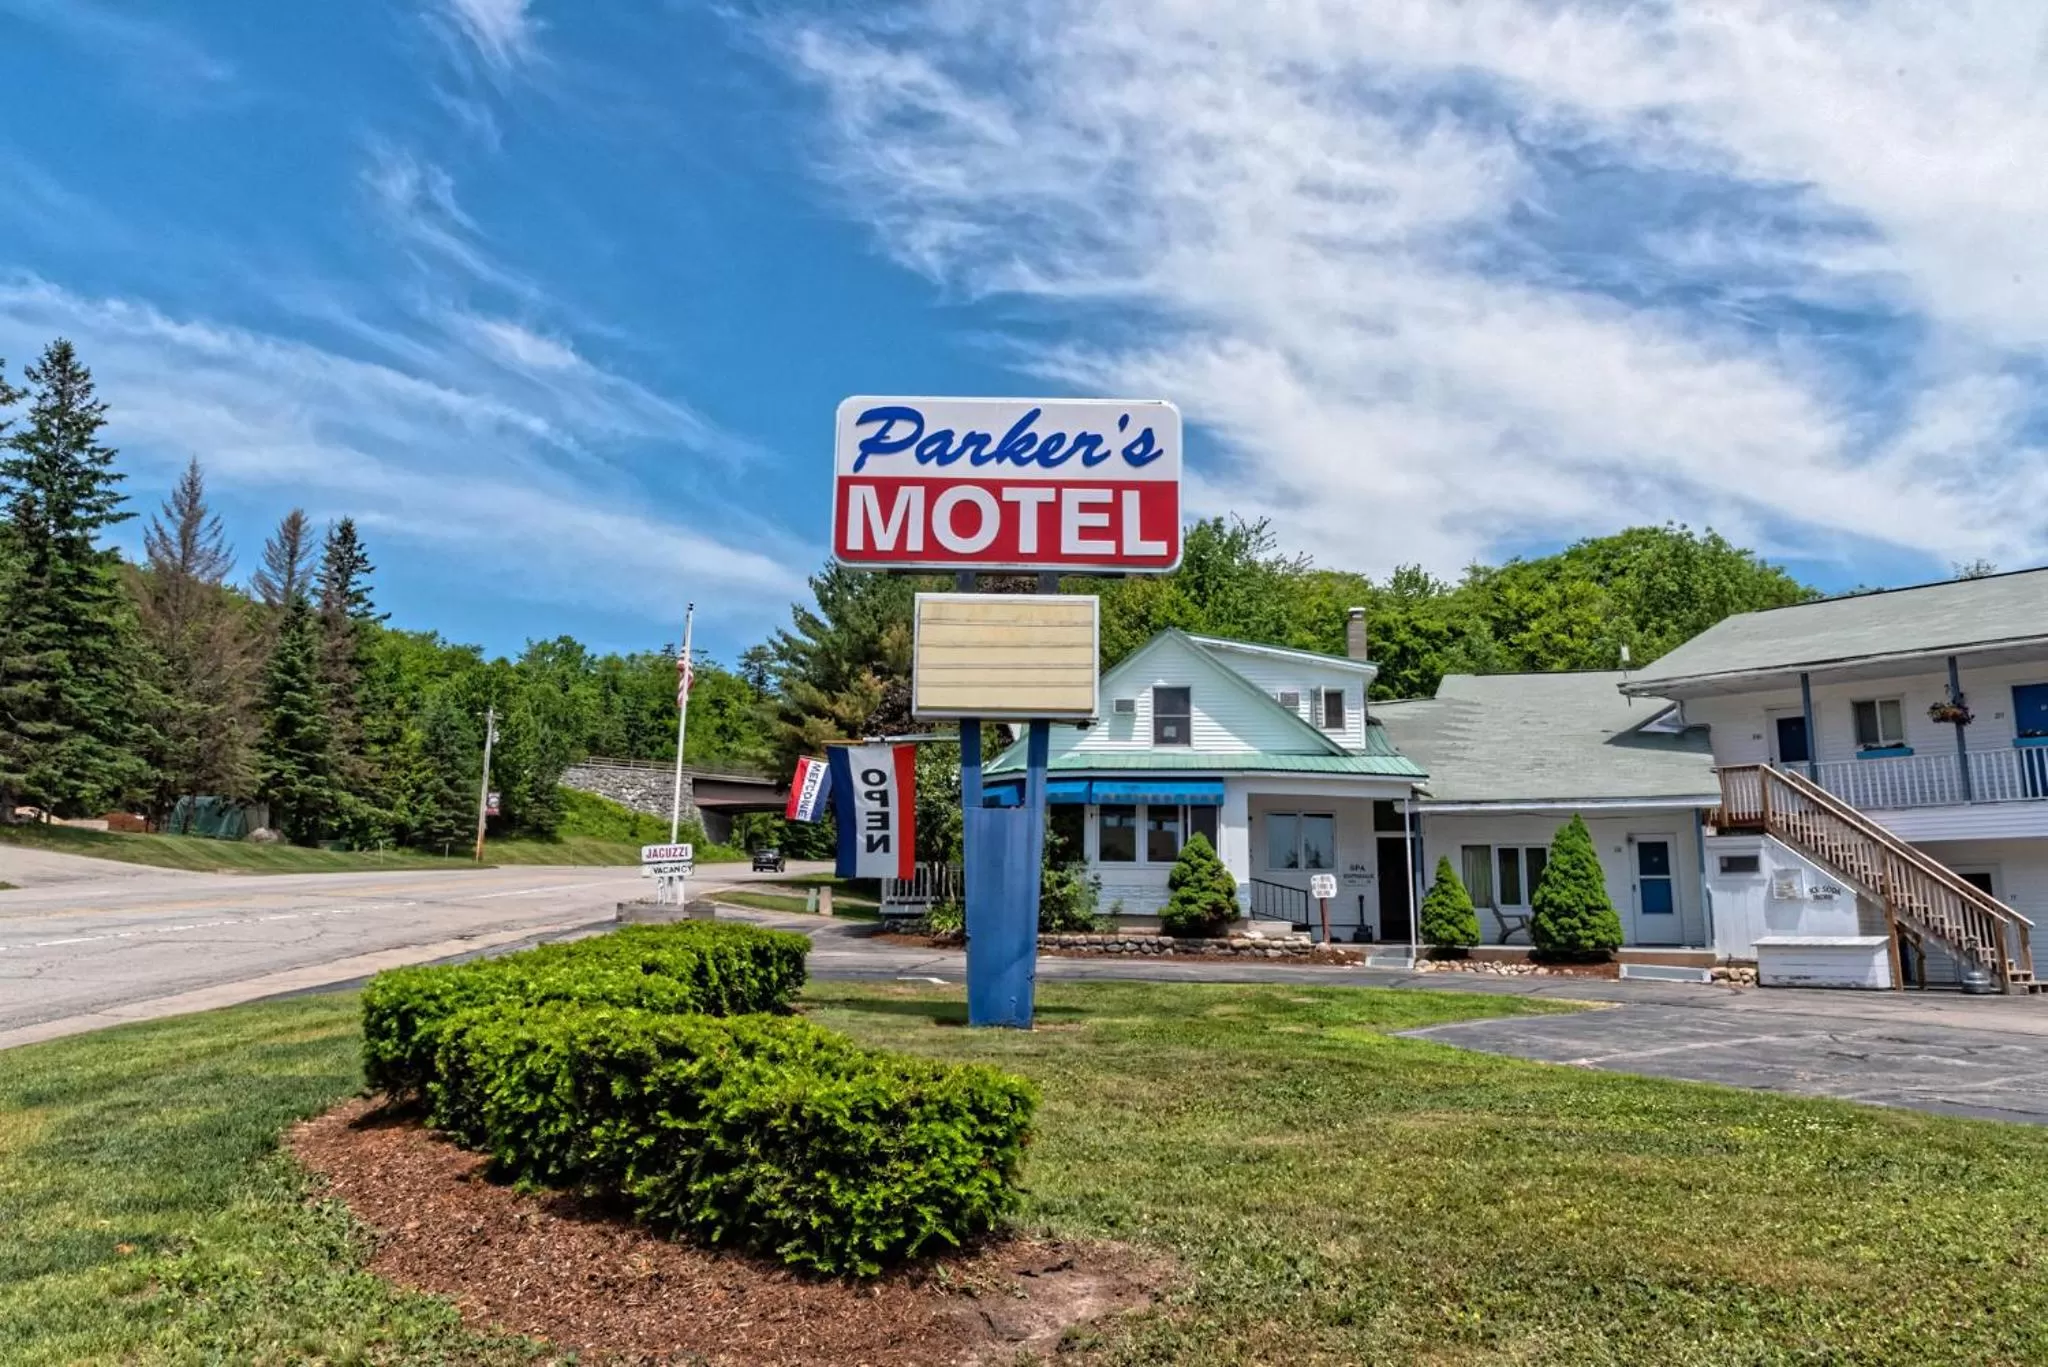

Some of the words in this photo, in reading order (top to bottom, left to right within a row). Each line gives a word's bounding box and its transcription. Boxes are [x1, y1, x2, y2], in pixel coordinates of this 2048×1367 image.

[855, 406, 1164, 473] Parker's
[846, 485, 1168, 556] MOTEL
[646, 846, 688, 859] JACUZZI
[653, 865, 692, 874] VACANCY
